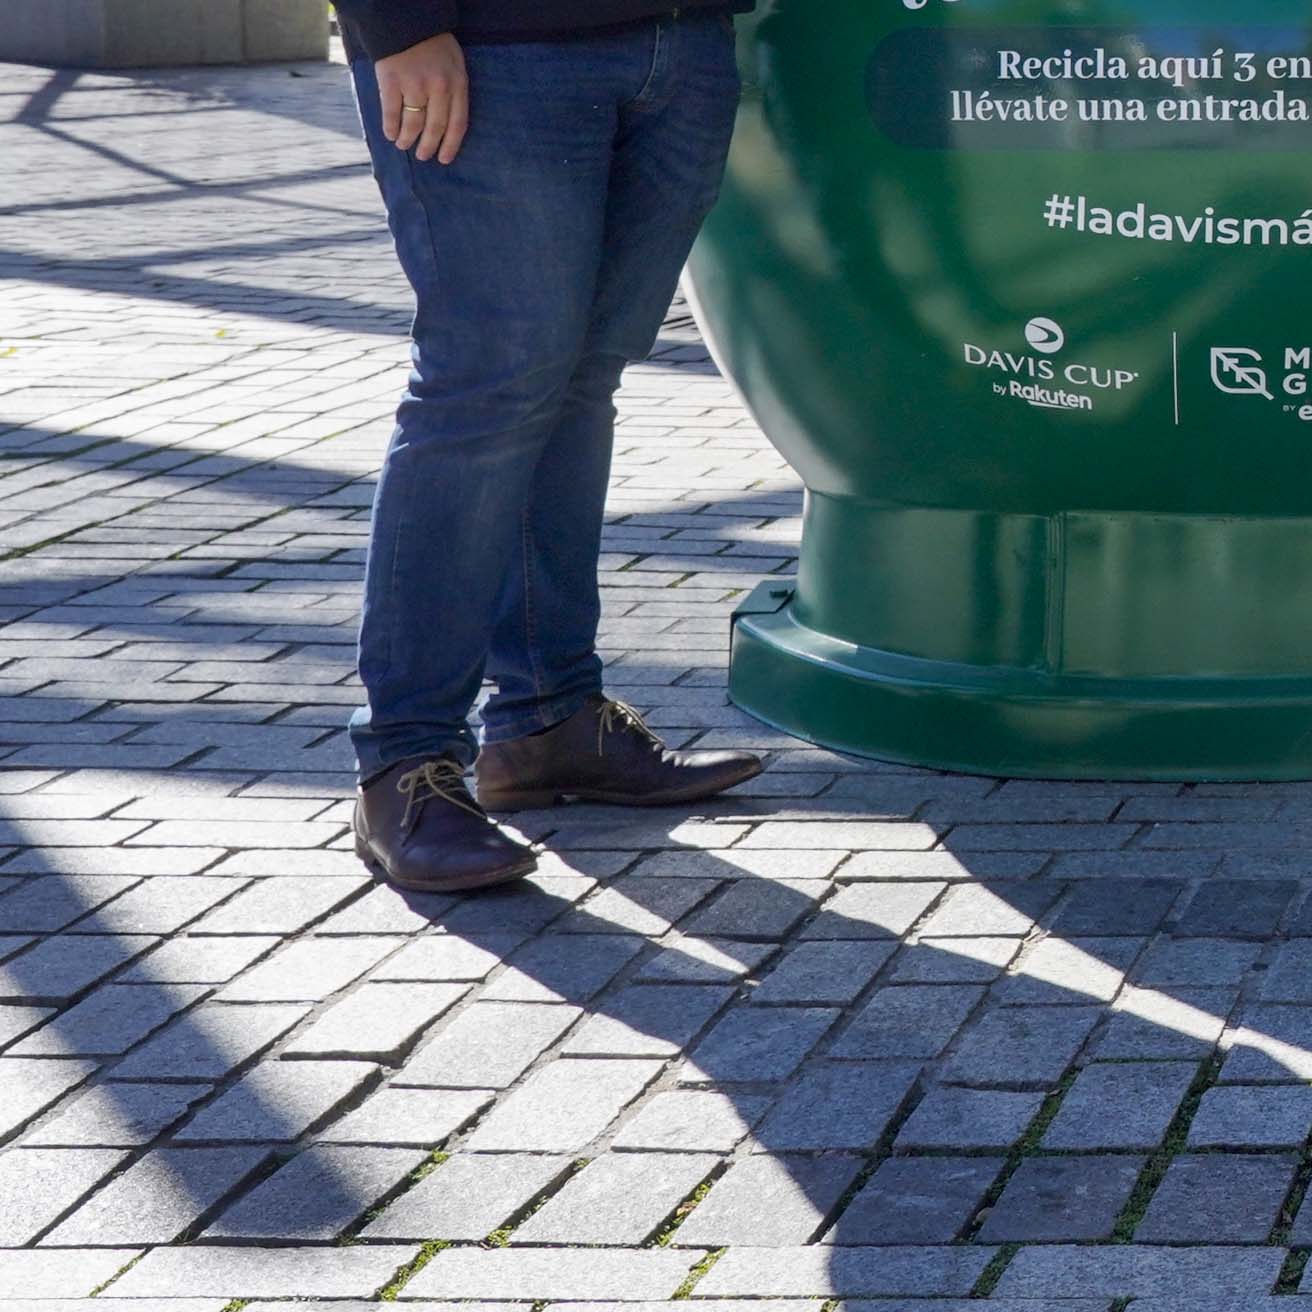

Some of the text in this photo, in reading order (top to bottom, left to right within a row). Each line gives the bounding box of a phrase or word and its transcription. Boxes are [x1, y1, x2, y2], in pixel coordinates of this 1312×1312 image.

[998, 48, 1130, 80] Recicla
[1138, 48, 1223, 87] aquí
[1234, 53, 1256, 82] 3
[951, 90, 1068, 122] llévate
[1077, 99, 1148, 122] una
[1157, 90, 1309, 122] entrada
[963, 343, 1139, 390] DAVIS CUP
[992, 379, 1093, 410] by Rakuten
